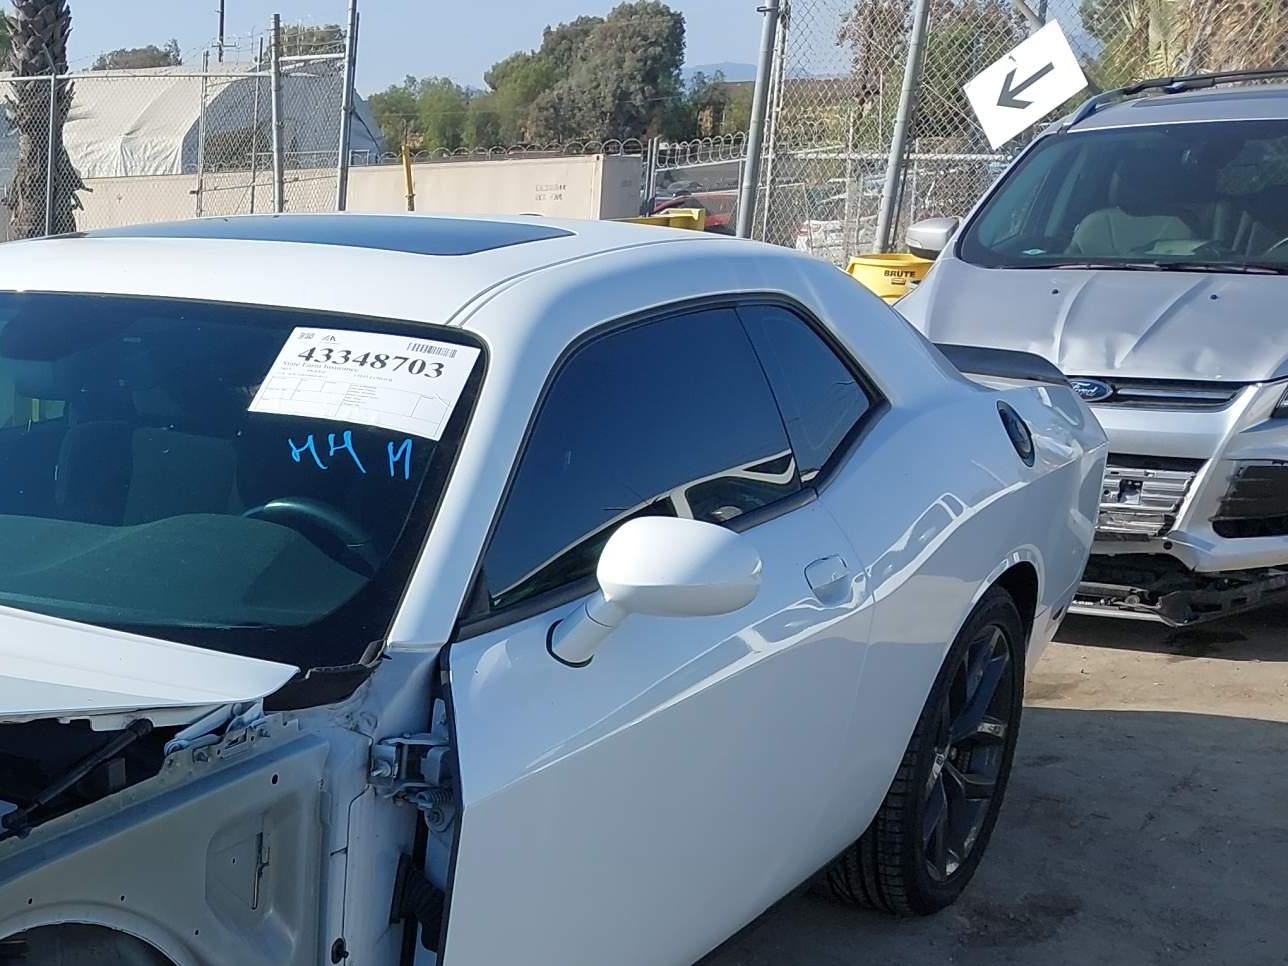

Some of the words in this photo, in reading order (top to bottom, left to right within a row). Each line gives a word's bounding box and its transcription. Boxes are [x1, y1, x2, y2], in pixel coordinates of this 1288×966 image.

[883, 269, 916, 278] BRUTE
[297, 346, 446, 379] 43348703
[1070, 381, 1098, 397] Ford
